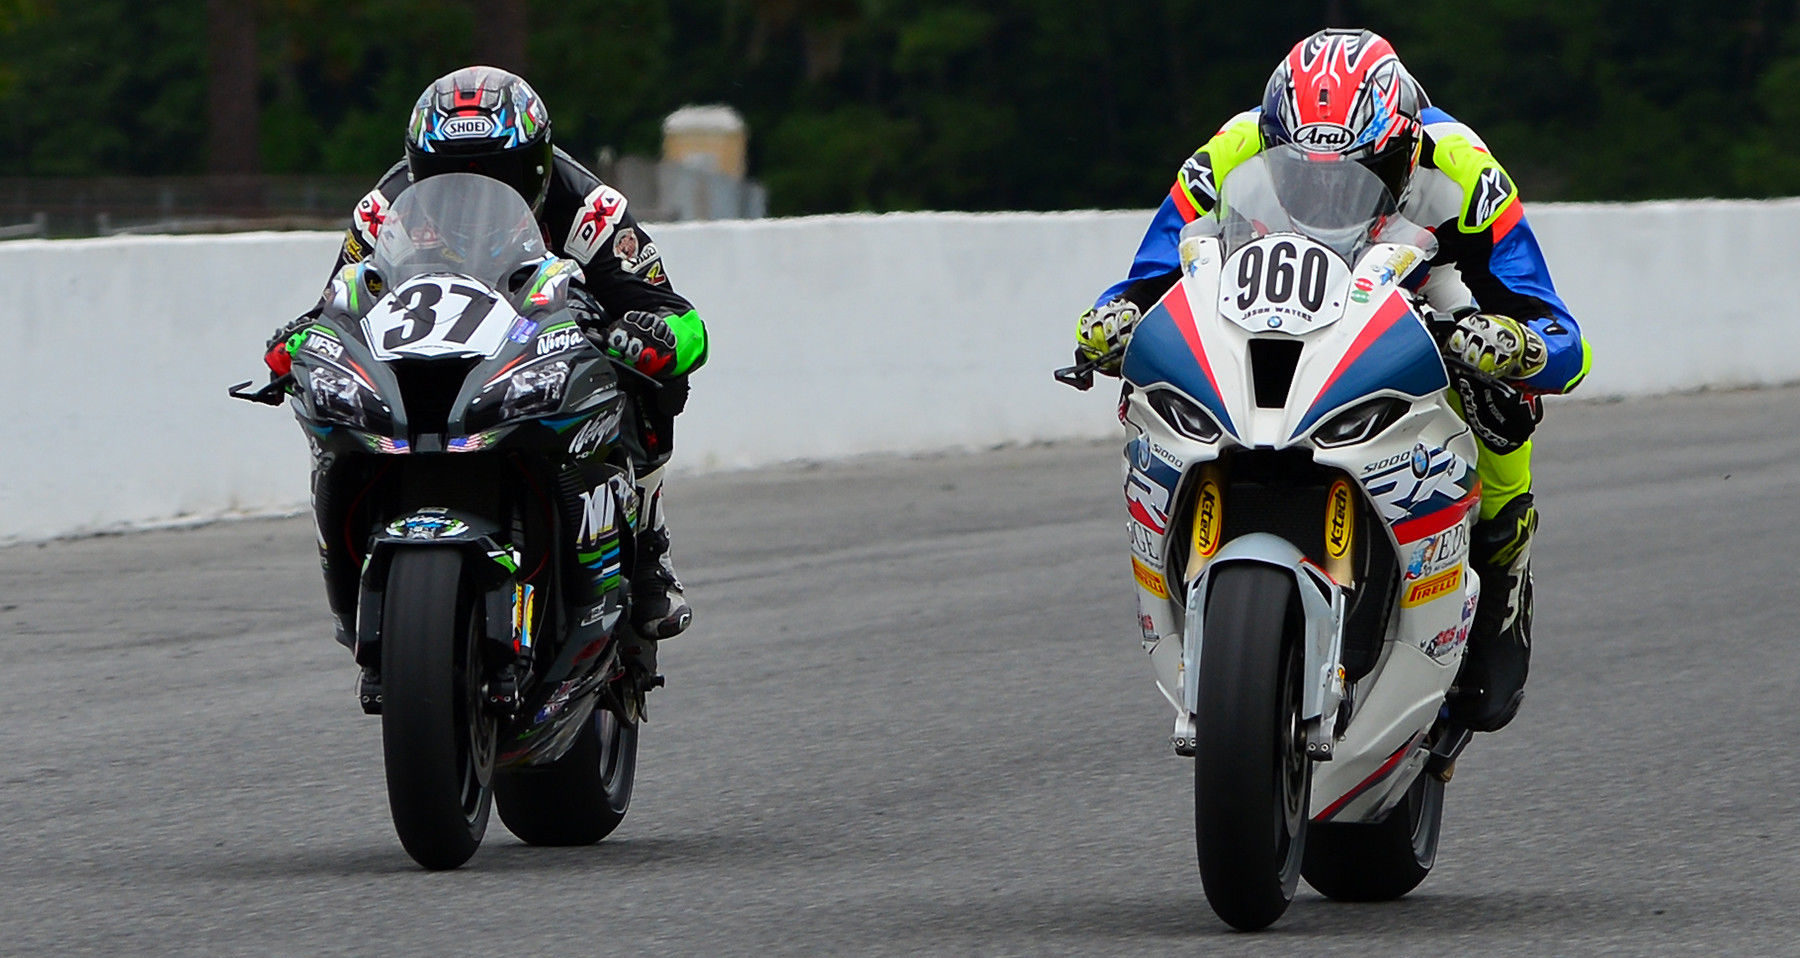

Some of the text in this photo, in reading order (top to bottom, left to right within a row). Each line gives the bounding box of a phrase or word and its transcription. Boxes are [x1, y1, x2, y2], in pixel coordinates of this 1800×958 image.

[450, 121, 485, 134] SHOEI
[1296, 127, 1347, 145] Arai
[1237, 241, 1329, 313] 960
[382, 277, 498, 351] 37
[1242, 307, 1313, 322] JASON WATERS
[536, 328, 584, 355] Ninja
[1152, 443, 1183, 469] S1000
[1363, 450, 1411, 473] S1000
[1408, 570, 1460, 602] PIRELLI
